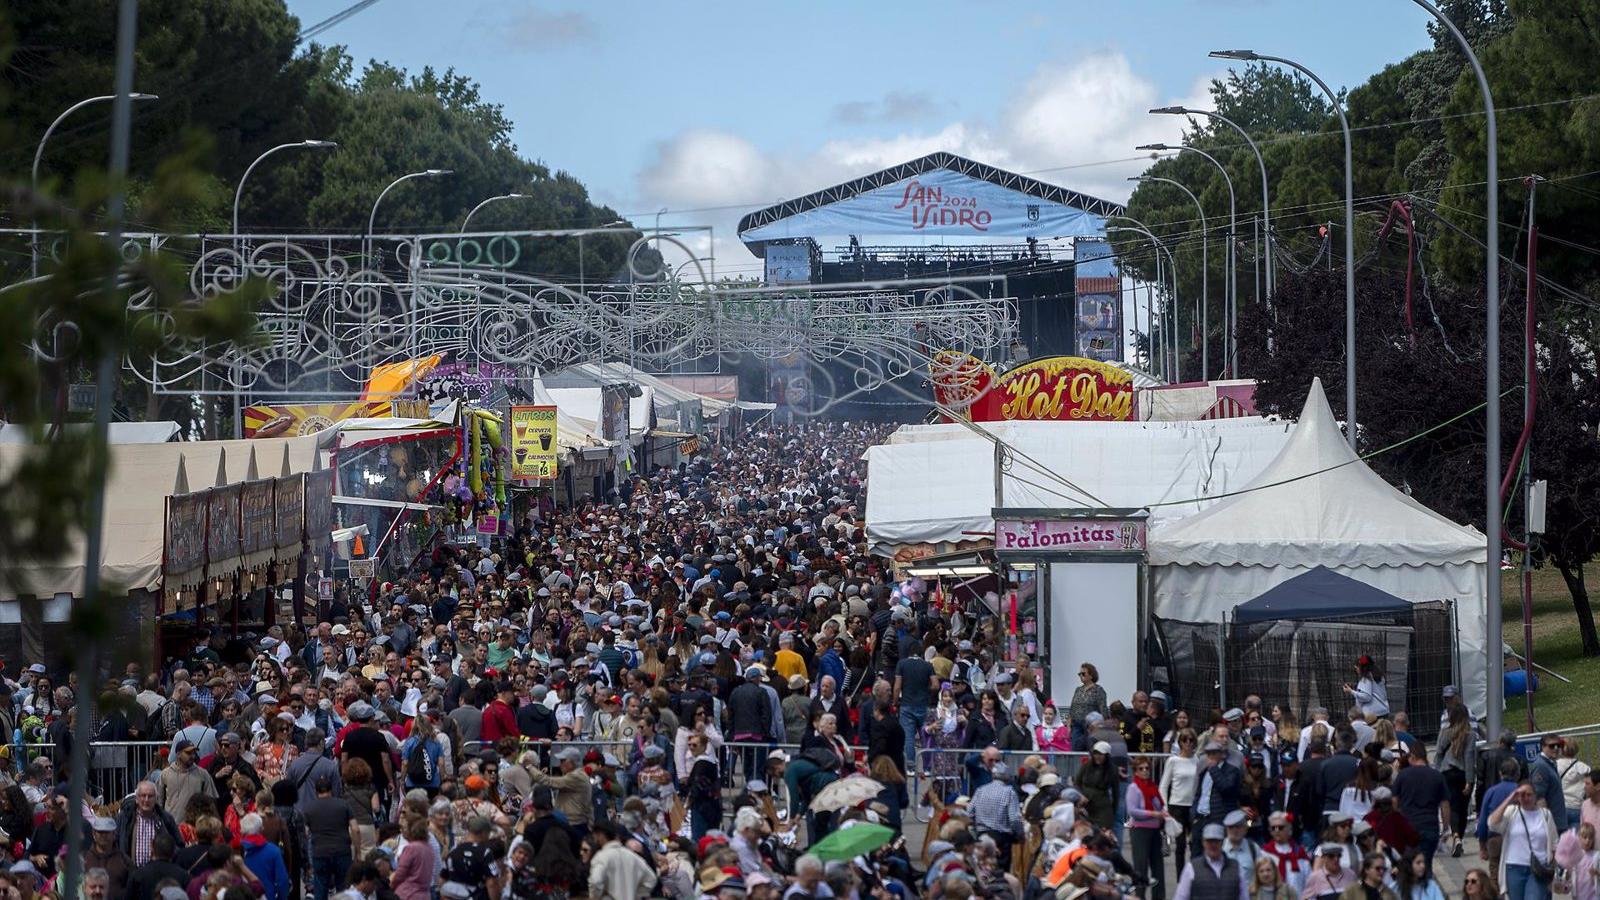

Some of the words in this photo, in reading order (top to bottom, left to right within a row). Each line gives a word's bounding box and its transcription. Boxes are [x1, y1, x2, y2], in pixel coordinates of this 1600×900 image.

[894, 179, 942, 209] SAN
[943, 195, 977, 208] 2024
[912, 204, 992, 231] ISIDRO
[1001, 372, 1067, 419] Hot
[1069, 373, 1132, 421] Dog
[513, 410, 555, 421] LITROS
[1004, 525, 1115, 548] Palomitas
